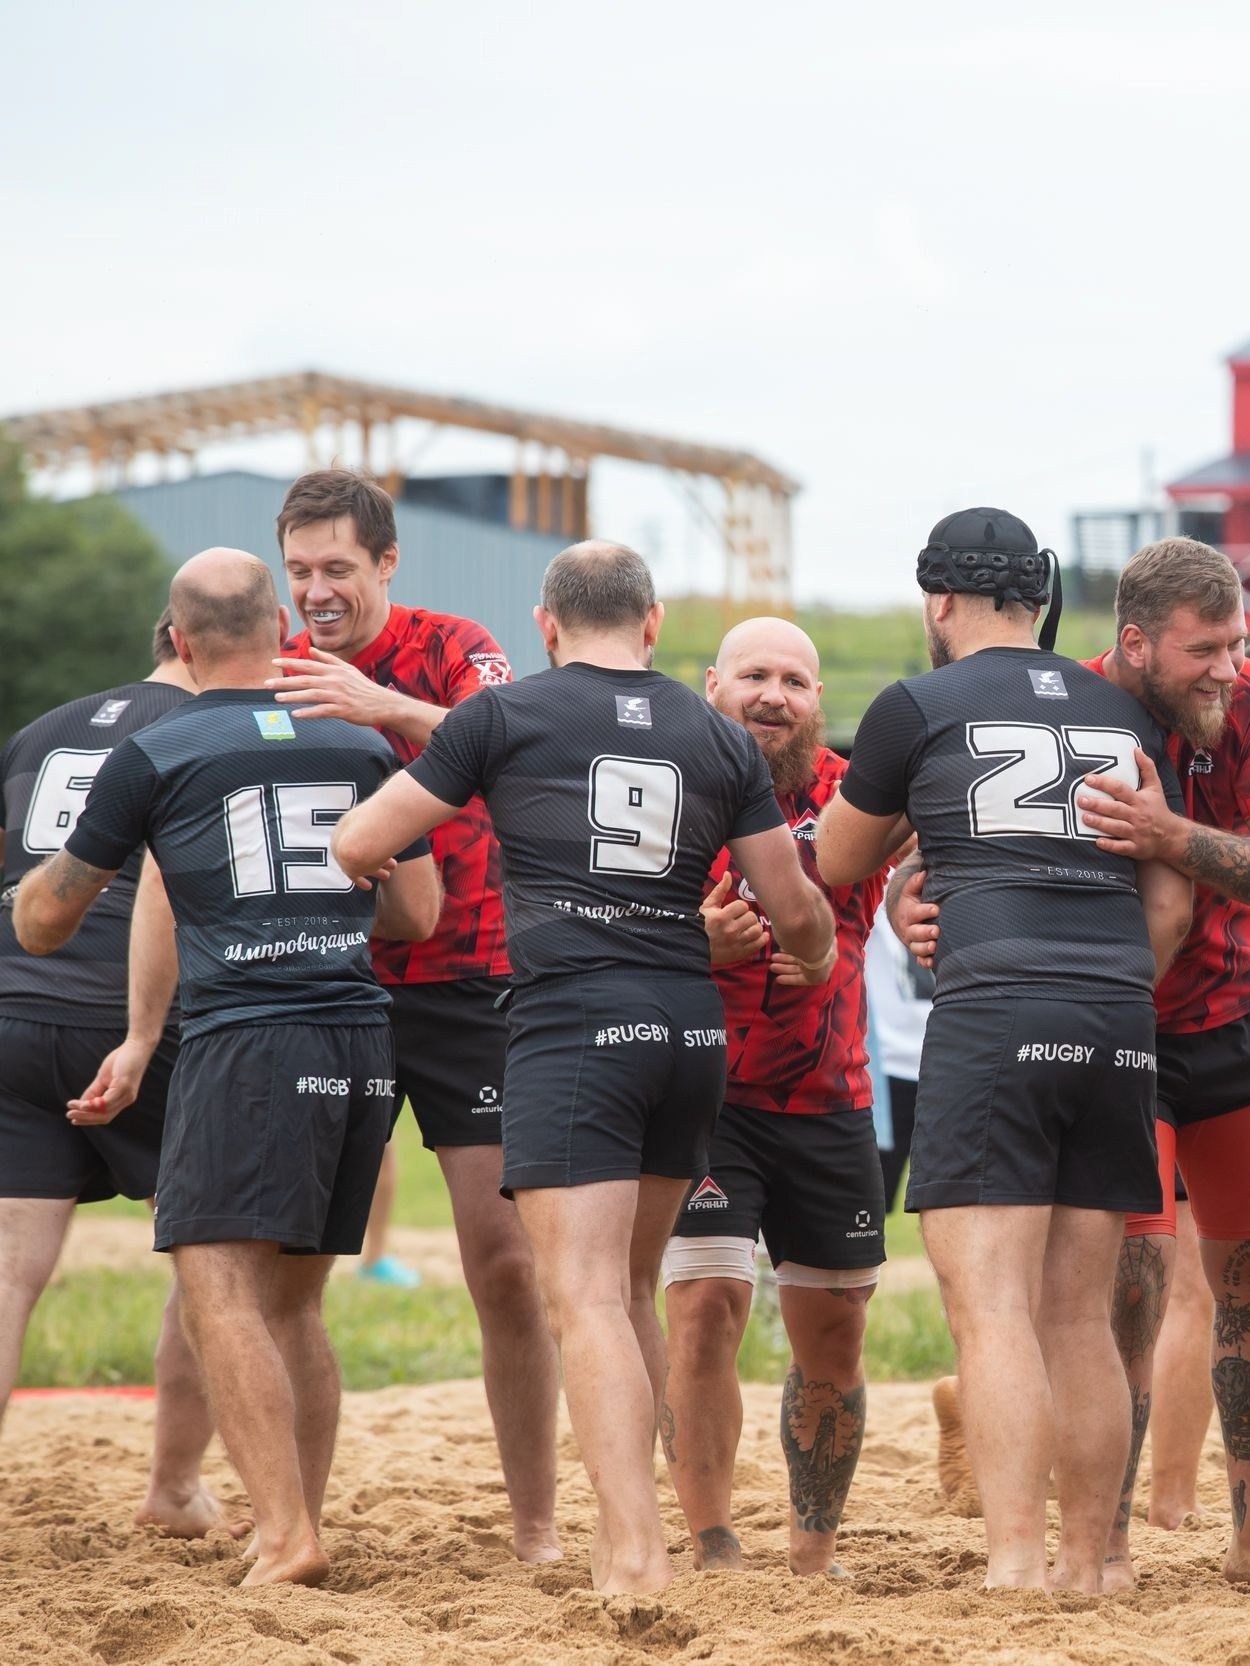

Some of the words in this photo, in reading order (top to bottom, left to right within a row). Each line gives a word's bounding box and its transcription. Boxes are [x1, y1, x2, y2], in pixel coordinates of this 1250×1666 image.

[965, 721, 1142, 842] 22
[588, 754, 683, 878] 9
[223, 781, 358, 898] 15
[1076, 869, 1105, 880] 2018
[303, 916, 329, 926] 2018
[224, 931, 368, 962] Импровизация
[594, 1023, 669, 1047] #RUGBY
[1016, 1043, 1095, 1065] #RUGBY
[296, 1076, 352, 1096] #RUGB
[687, 1200, 730, 1211] ГРАНИТ
[845, 1228, 879, 1239] centurion
